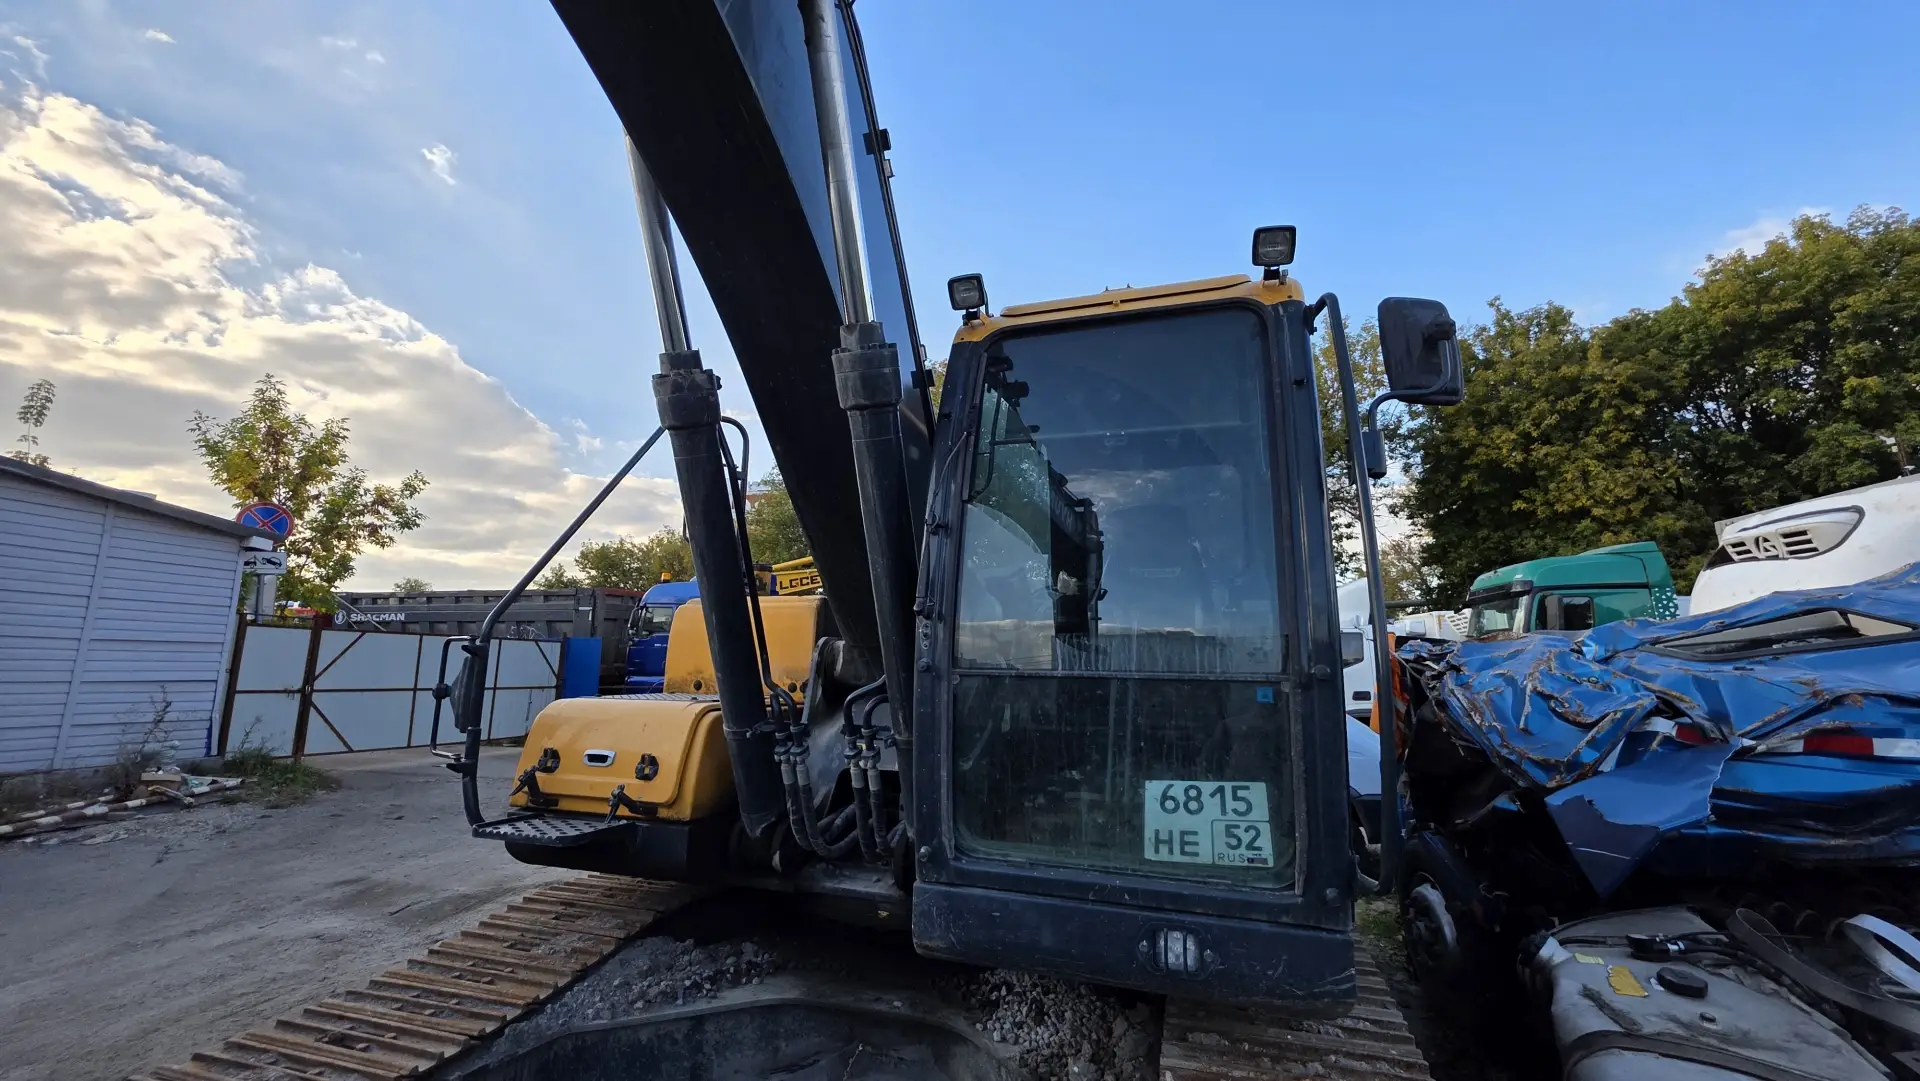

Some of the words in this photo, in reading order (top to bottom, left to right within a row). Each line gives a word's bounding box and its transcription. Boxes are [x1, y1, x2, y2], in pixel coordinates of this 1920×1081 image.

[779, 575, 821, 590] LGCE
[350, 613, 405, 621] SHACMAN
[1159, 783, 1253, 817] 6815
[1224, 824, 1263, 851] 52
[1217, 852, 1246, 863] RUS
